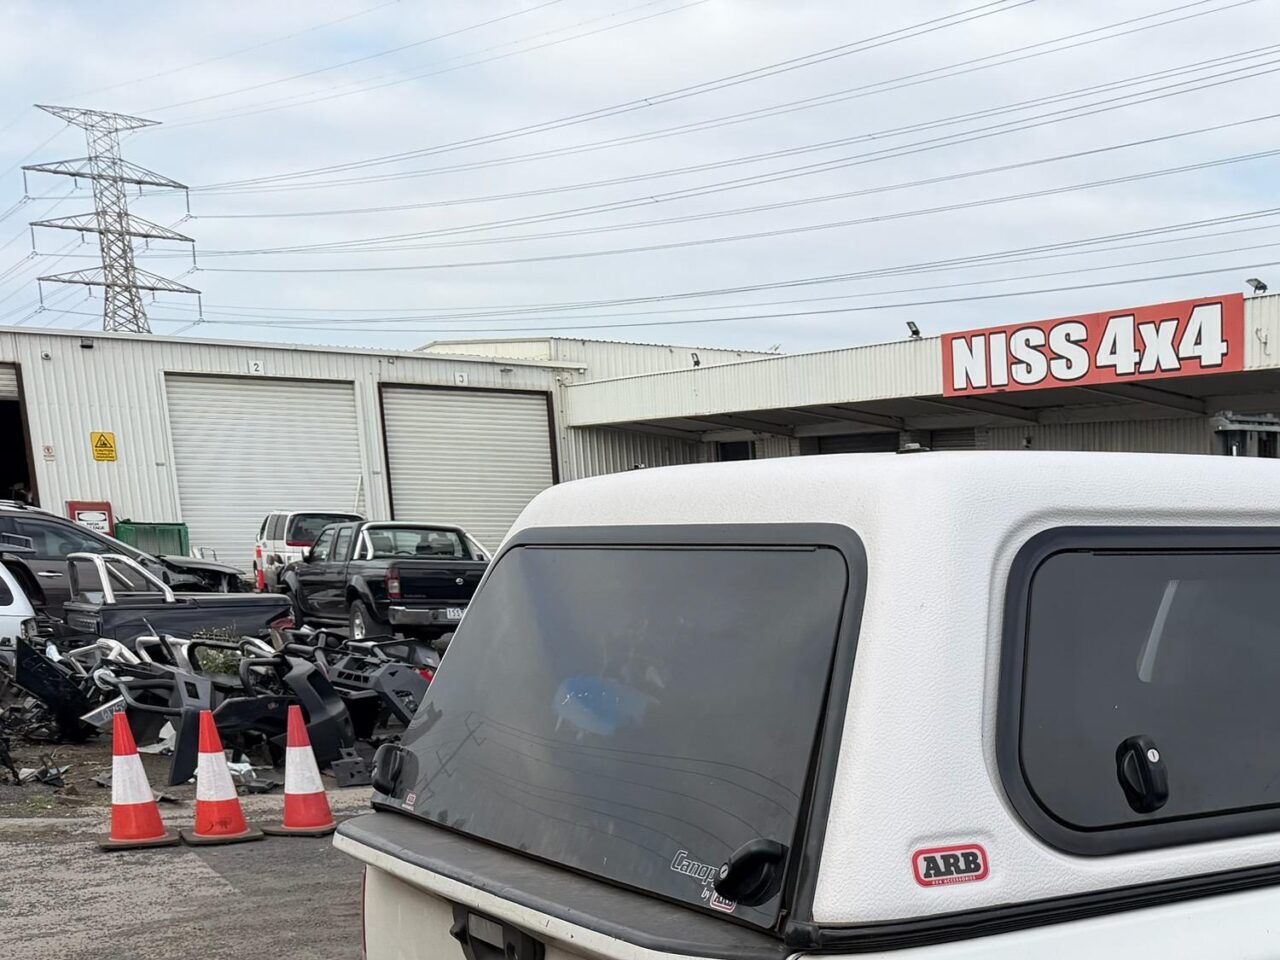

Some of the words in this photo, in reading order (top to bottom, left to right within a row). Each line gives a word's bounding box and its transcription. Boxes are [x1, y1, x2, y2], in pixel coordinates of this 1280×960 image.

[253, 363, 260, 372] 2
[458, 374, 465, 383] 3
[670, 849, 721, 885] Canop
[923, 851, 982, 879] ARB
[701, 887, 712, 902] by
